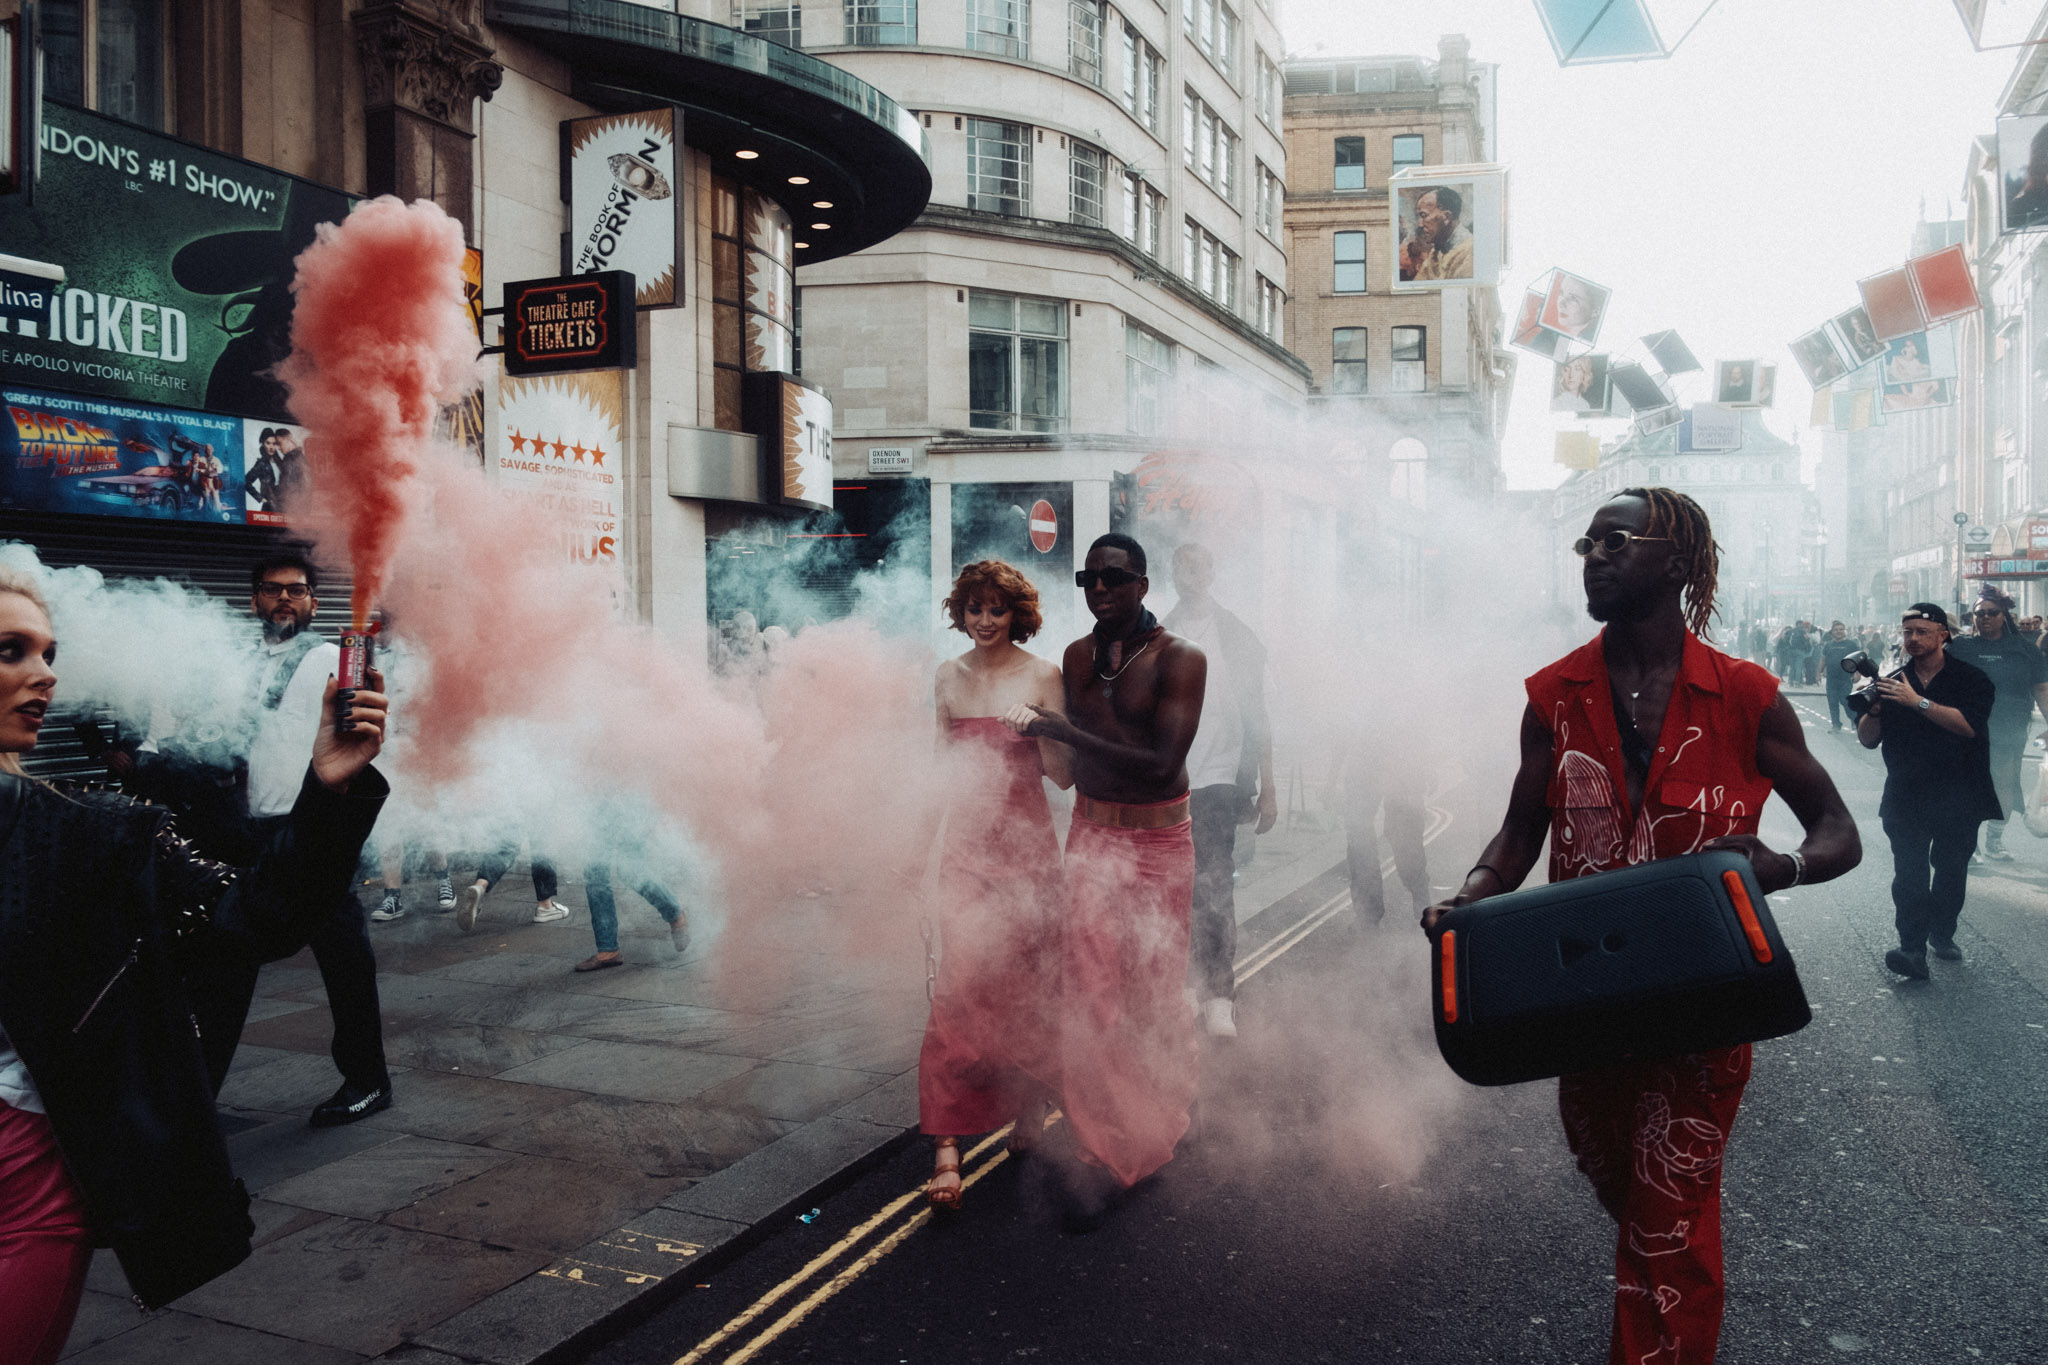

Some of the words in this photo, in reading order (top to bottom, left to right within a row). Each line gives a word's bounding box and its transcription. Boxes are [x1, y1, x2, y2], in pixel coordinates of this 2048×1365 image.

[40, 124, 140, 175] NDON’S
[149, 158, 176, 186] #1
[125, 180, 144, 193] LBC
[576, 245, 593, 270] THE
[589, 204, 612, 243] BOOK
[607, 183, 620, 202] OF
[528, 303, 569, 322] THEATRE
[571, 300, 595, 318] CAFE
[557, 293, 567, 303] THE
[0, 287, 187, 363] ICKED
[528, 319, 596, 351] TICKETS
[13, 352, 70, 373] APOLLO
[72, 361, 135, 383] VICTORIA
[138, 371, 188, 391] THEATRE
[8, 406, 119, 445] BACK
[45, 398, 84, 411] SCOTT!
[86, 403, 109, 415] THIS
[163, 414, 172, 422] A
[173, 415, 202, 427] TOTAL
[805, 420, 831, 461] THE
[19, 441, 43, 456] TO
[41, 444, 119, 467] FUTURE
[68, 465, 86, 474] THE
[85, 463, 119, 473] MUSICAL
[545, 464, 615, 485] SOPHISTICATED
[602, 521, 615, 532] OF
[2031, 525, 2048, 535] SO
[349, 1089, 381, 1112] NOWHERE
